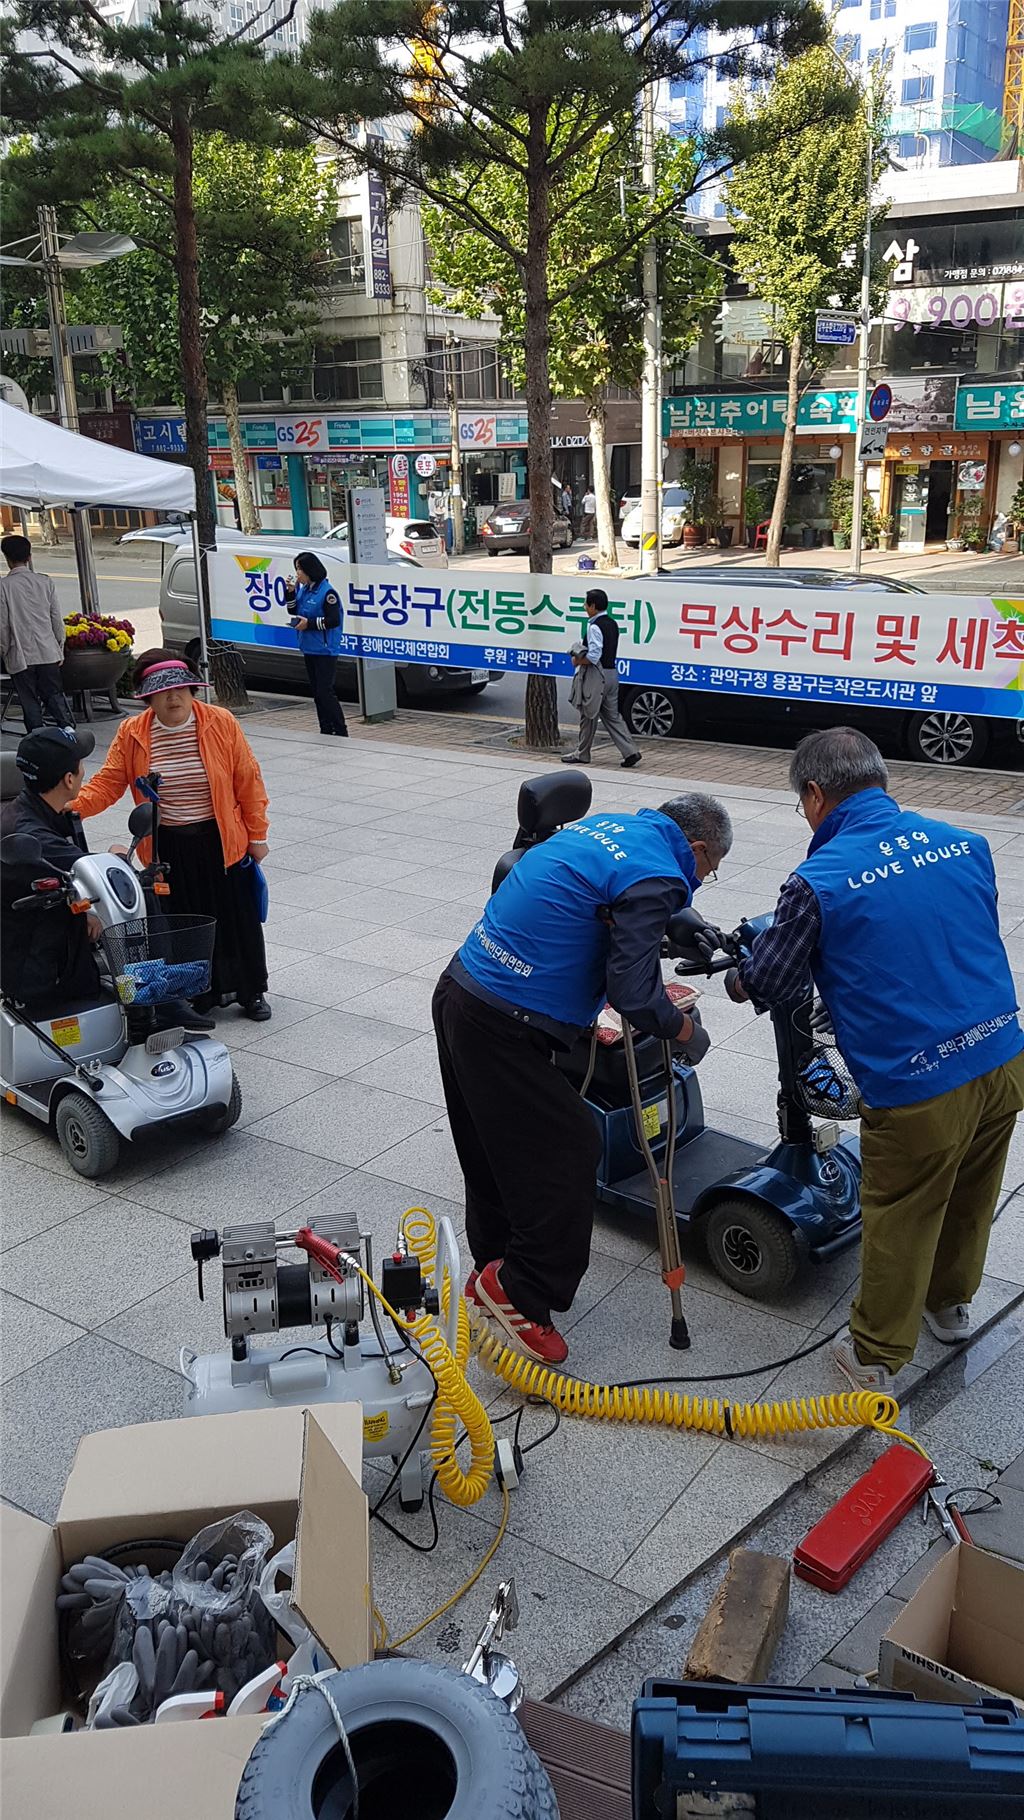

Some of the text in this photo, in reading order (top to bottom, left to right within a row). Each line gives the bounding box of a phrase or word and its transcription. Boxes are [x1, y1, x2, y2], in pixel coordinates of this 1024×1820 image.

[970, 267, 986, 278] 문의
[374, 283, 391, 295] 9333
[277, 419, 322, 448] GS25
[460, 417, 496, 445] GS25
[417, 460, 432, 471] 로또
[678, 603, 856, 662] 무상수리
[873, 614, 920, 667] 및
[361, 636, 450, 660] 장애인단체연합회
[483, 647, 507, 665] 후원
[516, 650, 553, 669] 관악구
[671, 664, 698, 682] 장소
[709, 667, 768, 689] 관악구청
[920, 684, 939, 704] 앞
[847, 841, 971, 889] LOVE HOUSE
[901, 1647, 958, 1684] TAISHIN
